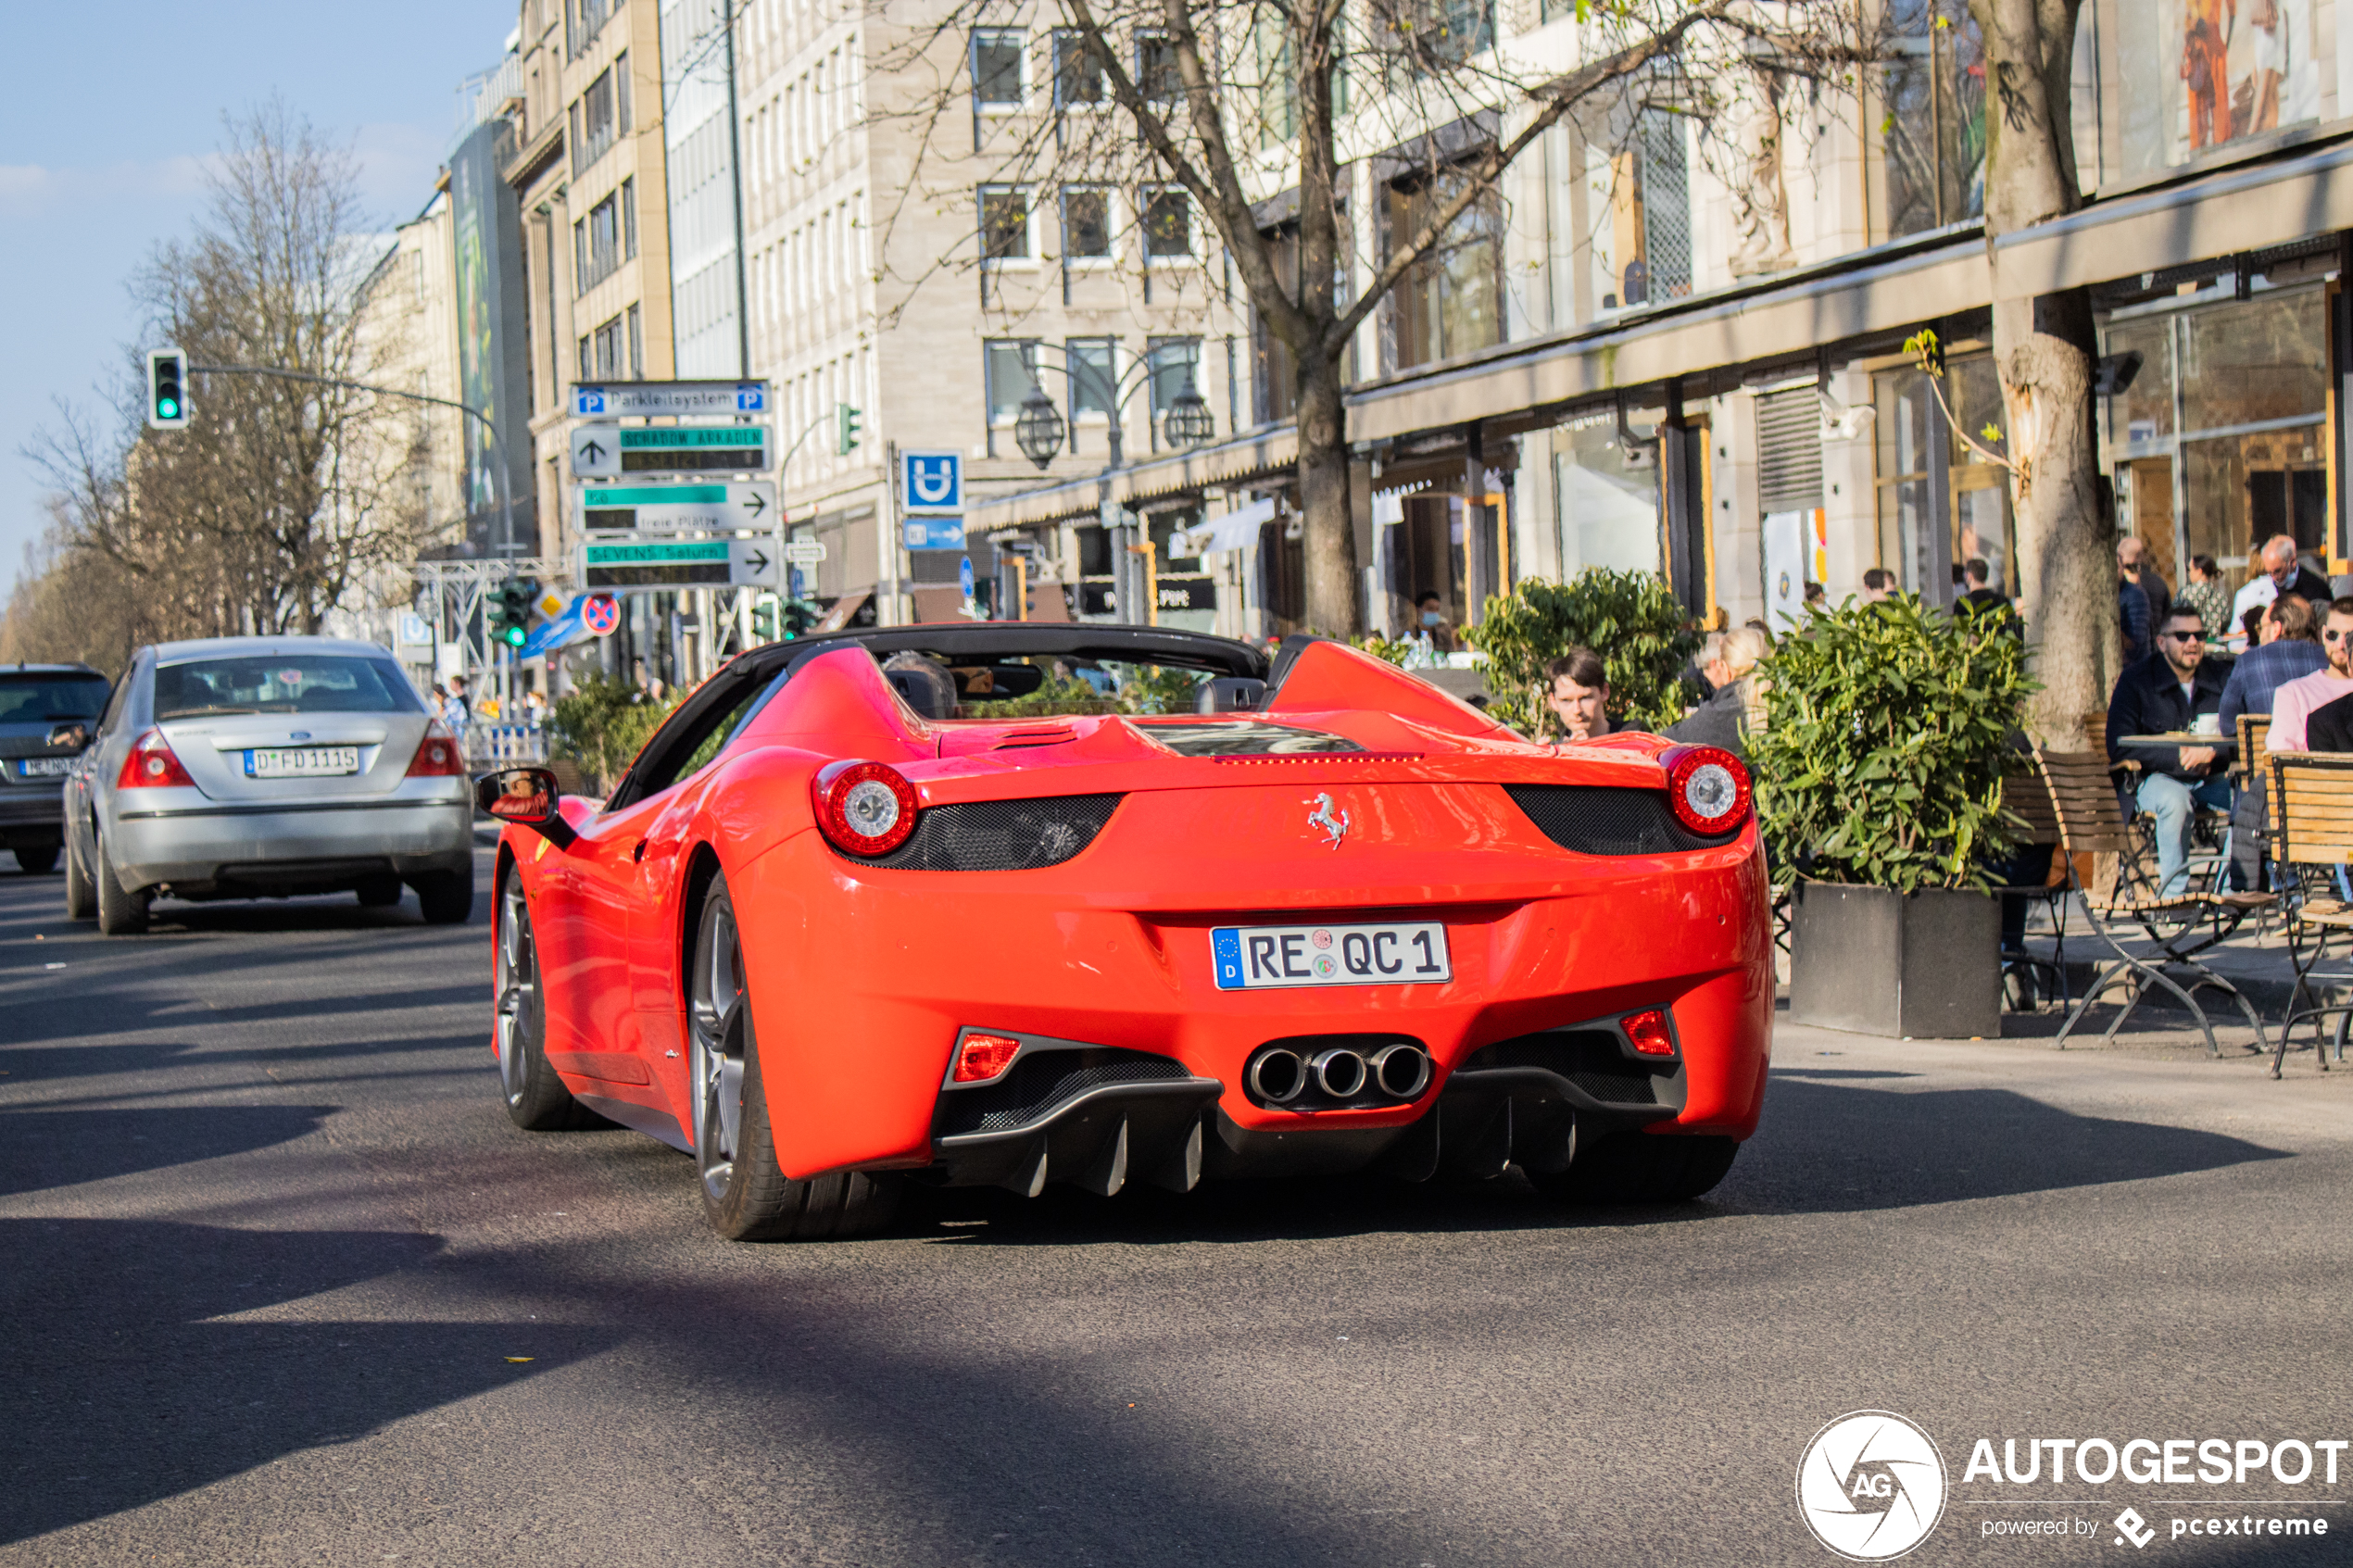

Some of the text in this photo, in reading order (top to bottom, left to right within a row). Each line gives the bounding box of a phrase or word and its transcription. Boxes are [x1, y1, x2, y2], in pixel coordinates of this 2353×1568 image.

[610, 391, 733, 410] Parkleitsystem
[625, 429, 761, 445] SCHADOW ARKADEN
[641, 517, 673, 528] freie
[258, 753, 267, 769] D
[282, 751, 305, 769] FD
[310, 749, 355, 767] 1115
[1248, 935, 1311, 979] RE
[1342, 932, 1403, 975] QC
[1411, 930, 1441, 973] 1
[1225, 965, 1236, 978] D
